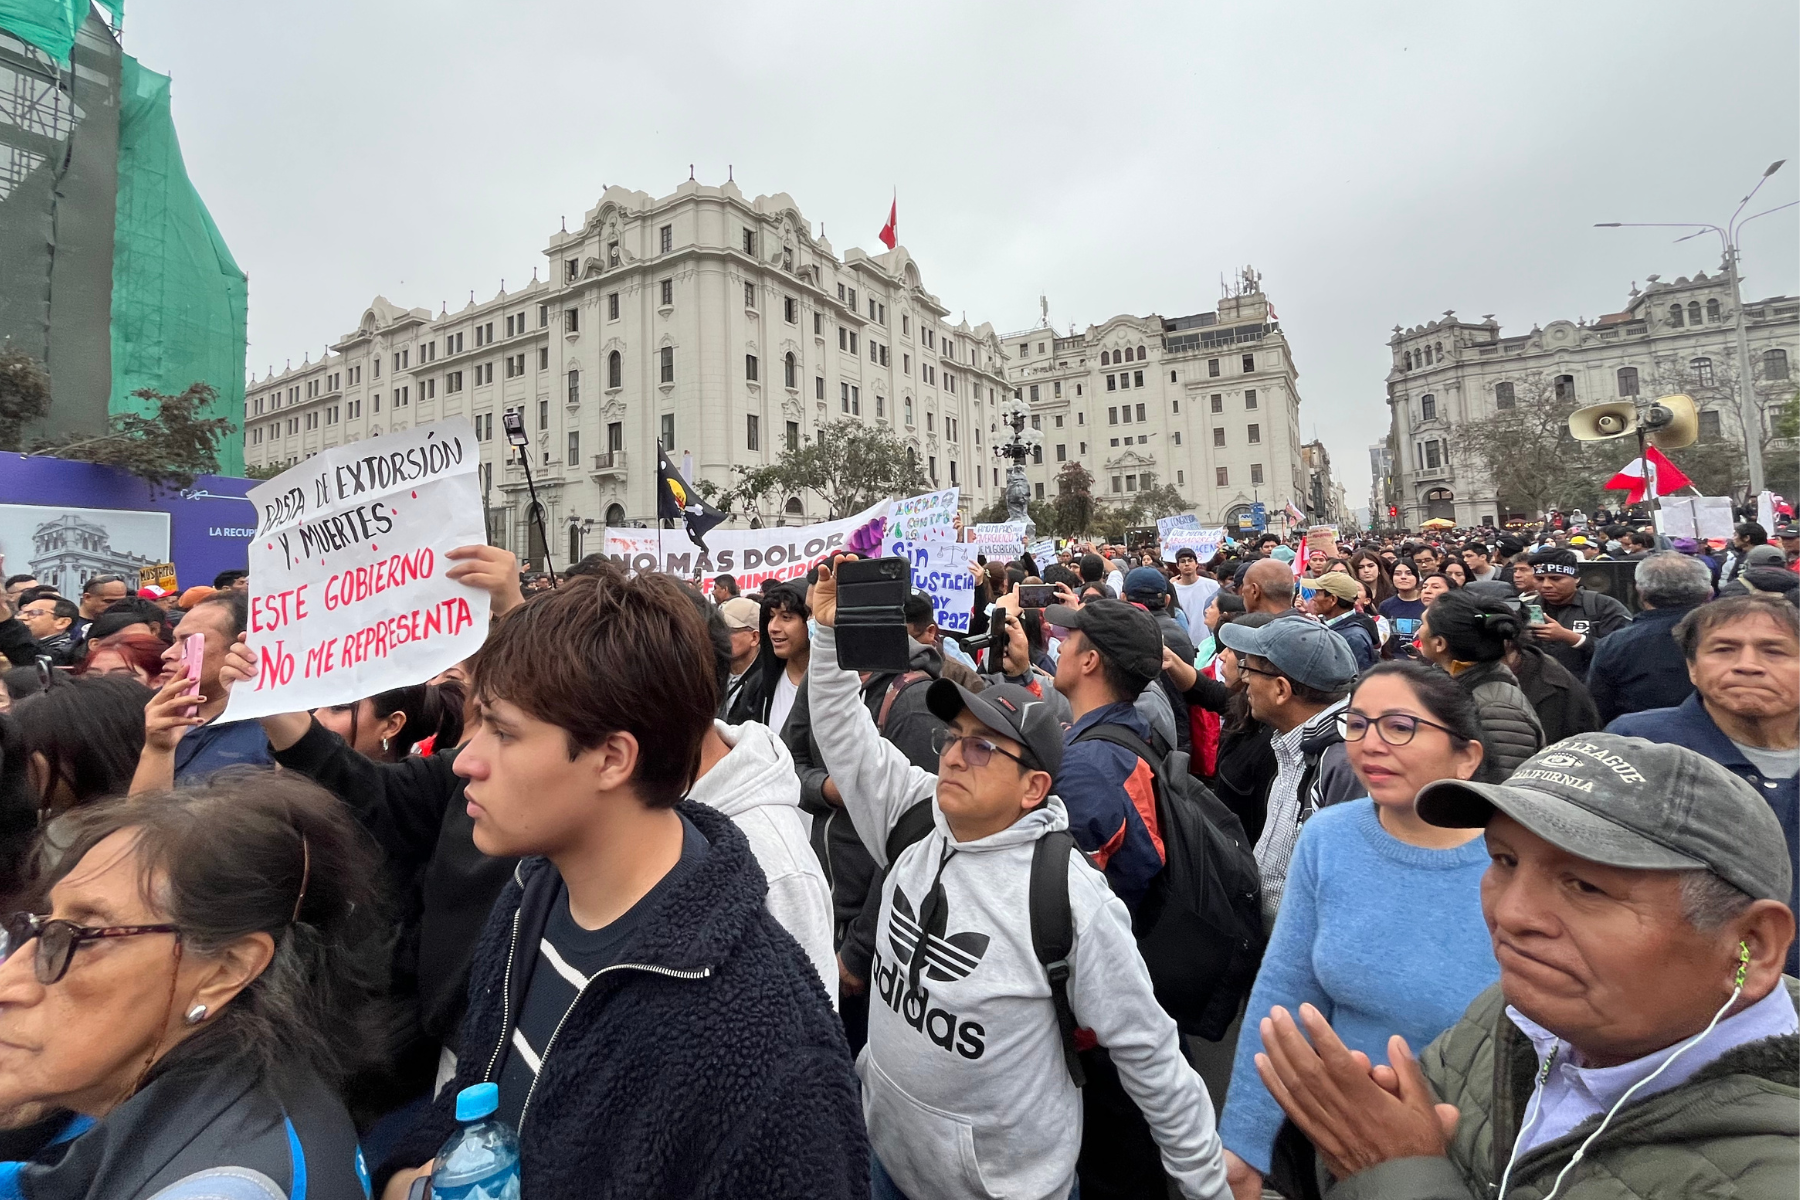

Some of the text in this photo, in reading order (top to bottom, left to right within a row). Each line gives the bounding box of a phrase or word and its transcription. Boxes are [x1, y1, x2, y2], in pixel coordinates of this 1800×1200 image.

[315, 473, 330, 508] DE
[335, 431, 463, 500] EXTORSIÓN
[209, 527, 257, 538] LA RECUP
[278, 502, 393, 571] Y MUERTES
[610, 552, 658, 574] NO
[743, 532, 845, 570] DOLOR
[251, 547, 434, 633] ESTE GOBIERNO
[1547, 563, 1576, 575] PERU
[304, 637, 338, 679] ME
[341, 597, 473, 668] REPRESENTA
[1566, 741, 1647, 784] LEAGUE
[872, 948, 986, 1060] adidas
